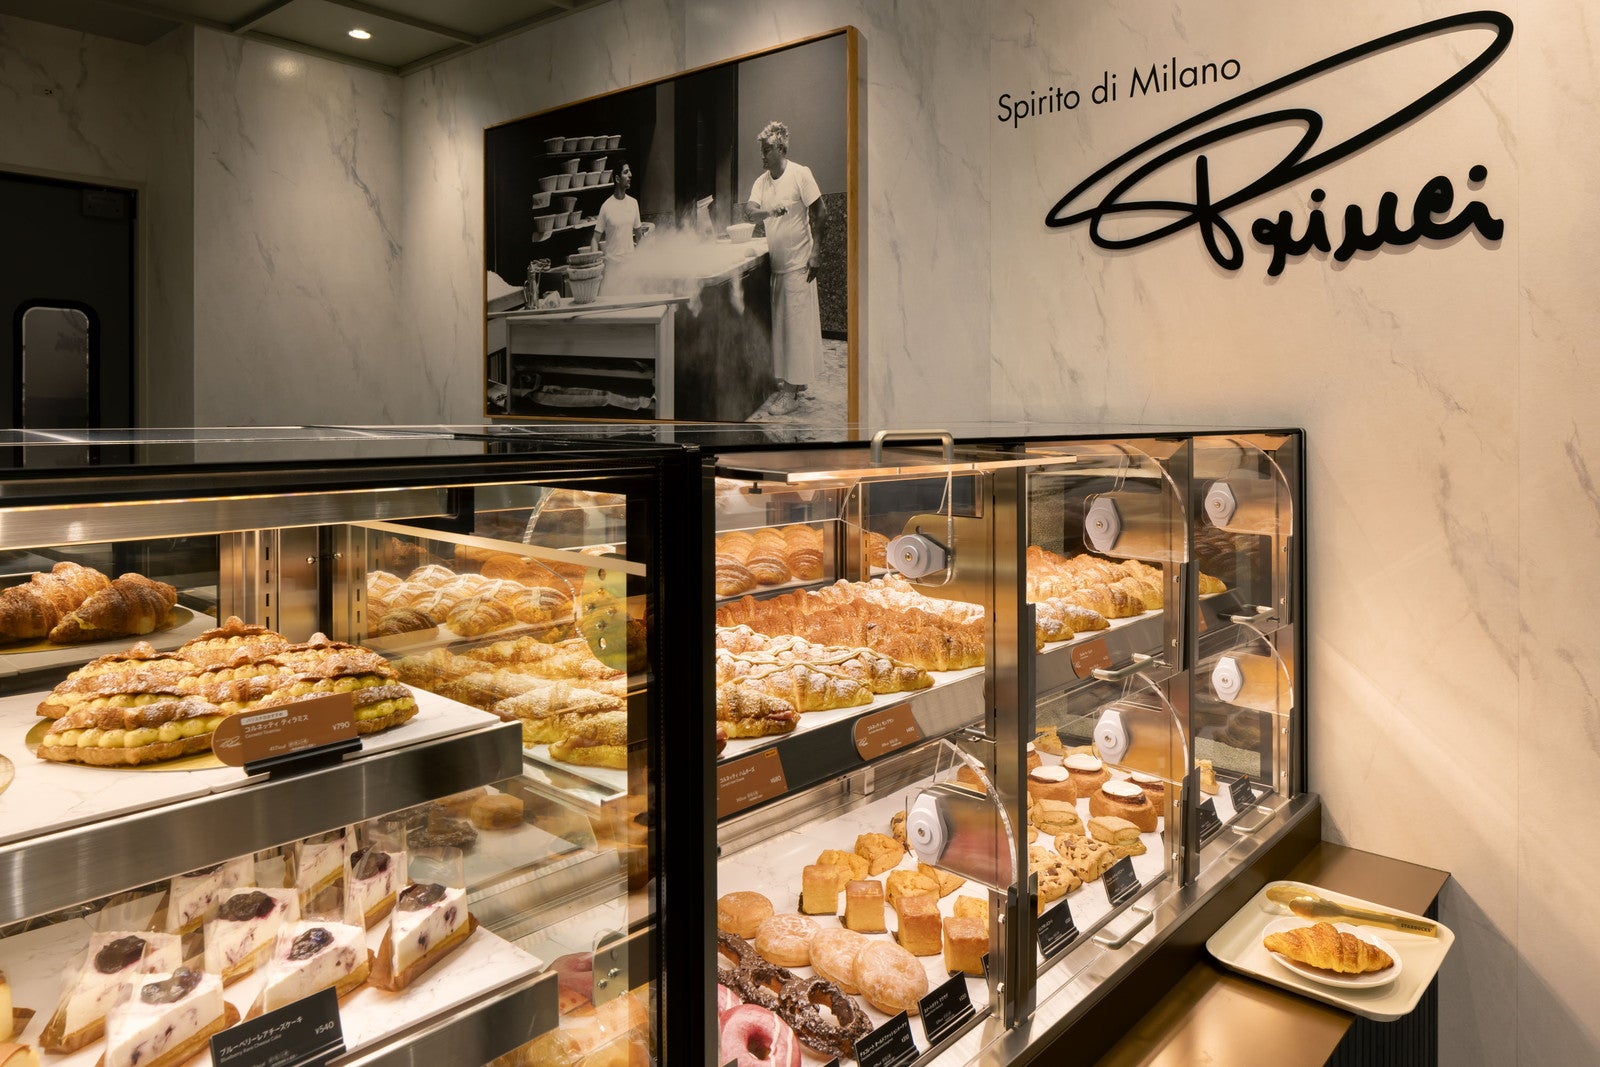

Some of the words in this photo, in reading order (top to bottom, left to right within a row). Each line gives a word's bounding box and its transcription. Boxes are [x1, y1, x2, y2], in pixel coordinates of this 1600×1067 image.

[997, 85, 1081, 129] Spirito
[1092, 72, 1117, 105] di
[1129, 57, 1242, 98] Milano
[244, 721, 279, 733] コルネッティ
[281, 714, 309, 726] ティラミス
[333, 722, 350, 731] ¥790
[1401, 924, 1432, 932] STARBUCKS
[220, 1016, 303, 1056] ブルーベリーレアチーズケーキ
[315, 1021, 334, 1035] ¥540
